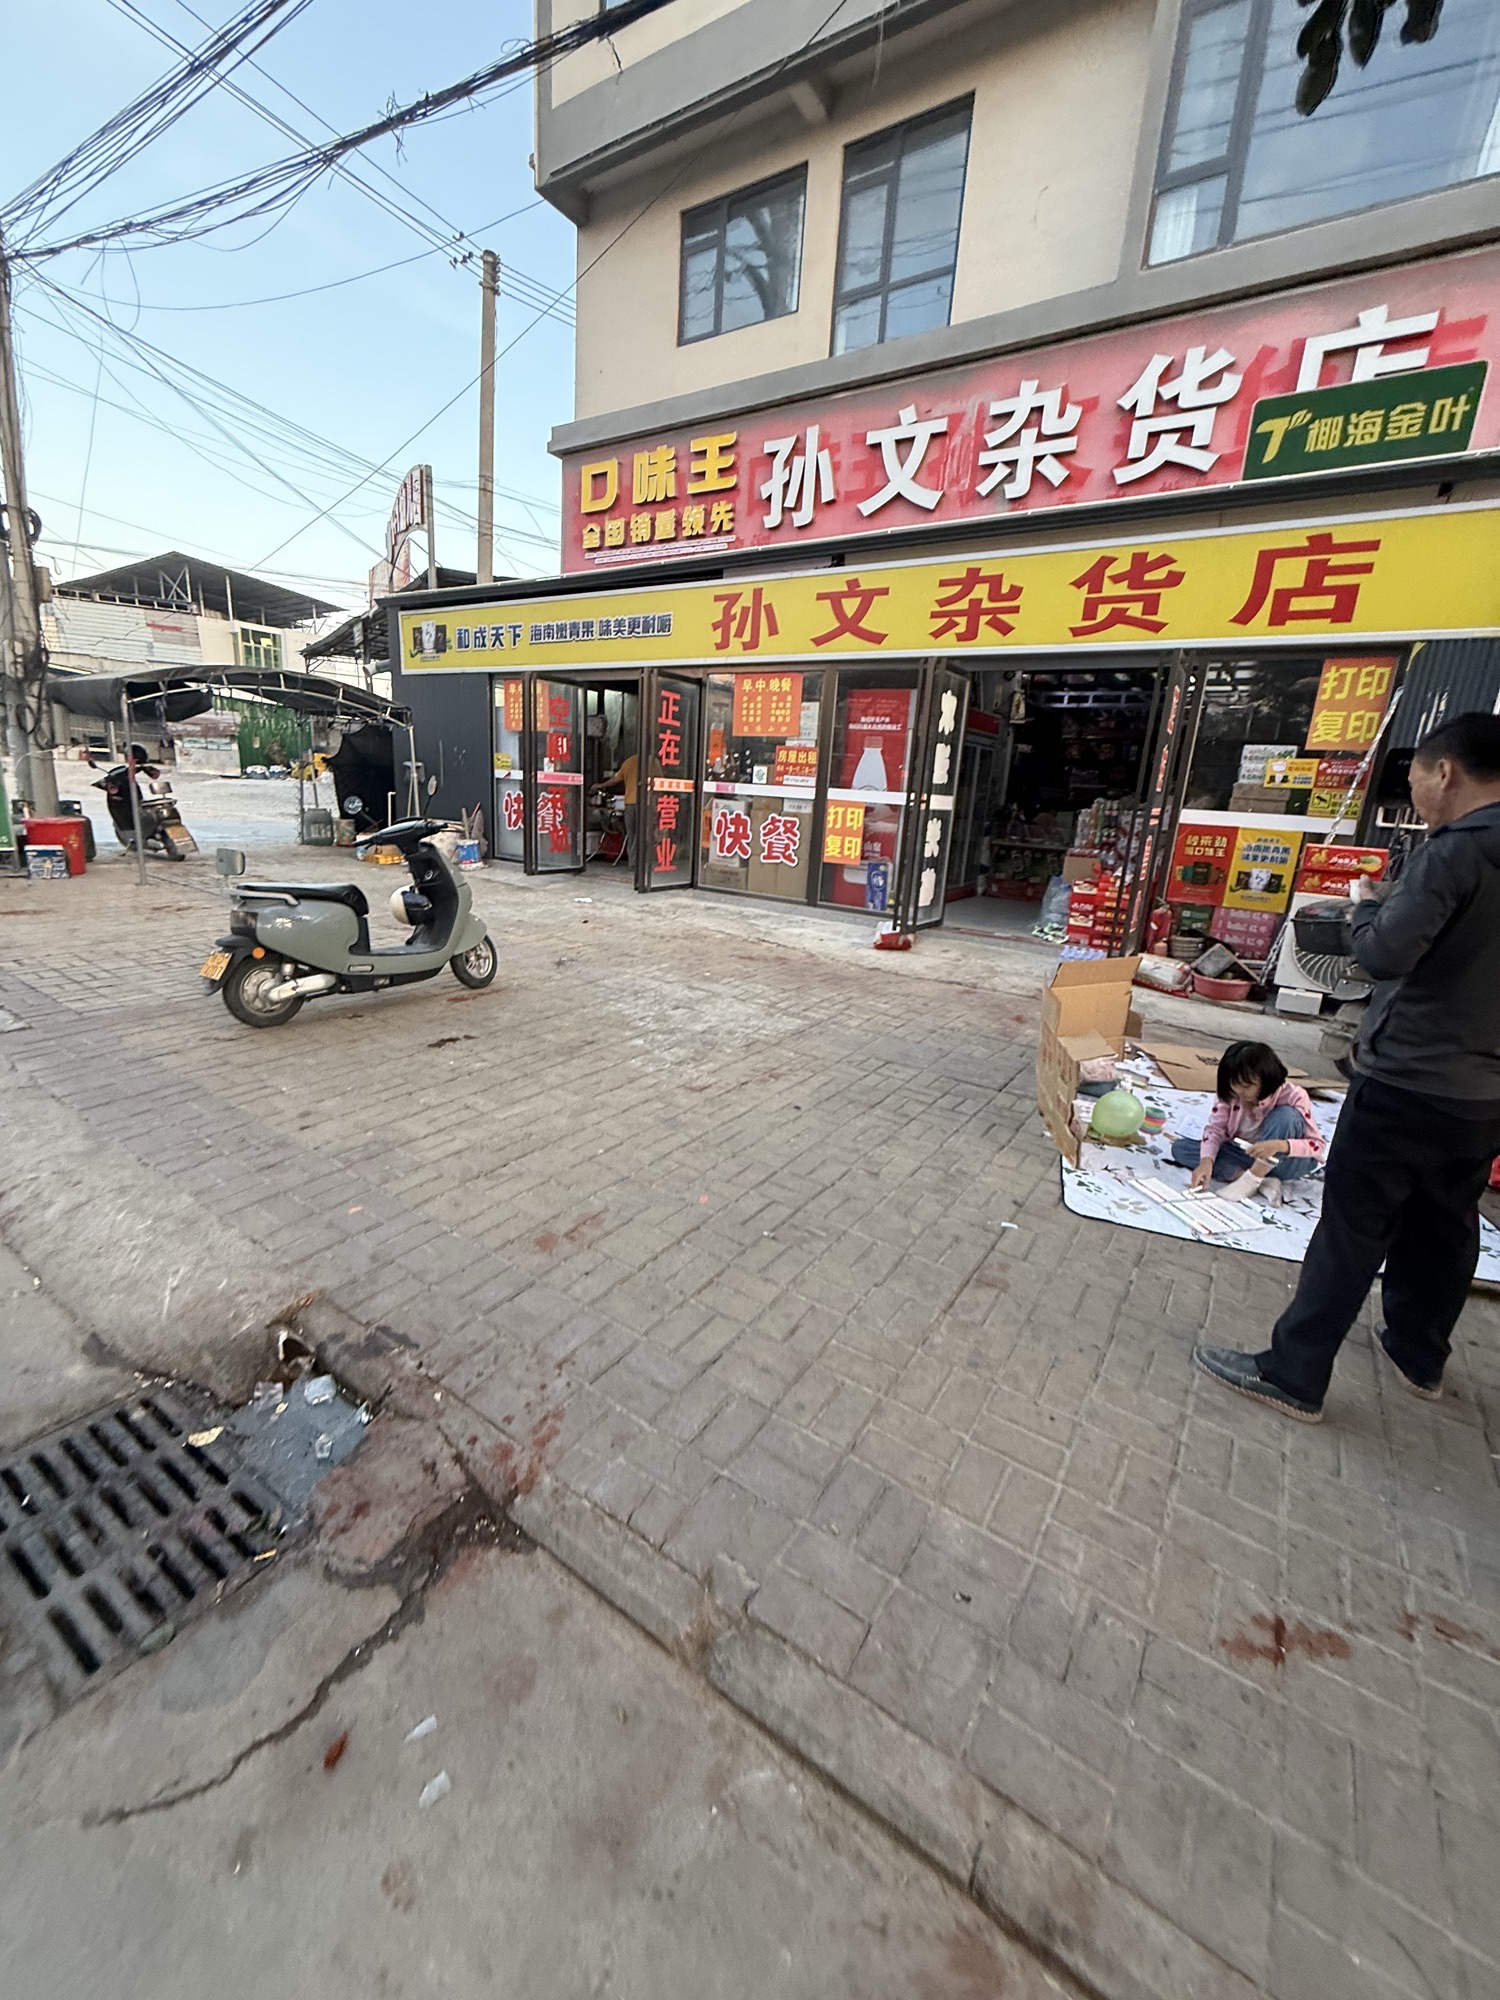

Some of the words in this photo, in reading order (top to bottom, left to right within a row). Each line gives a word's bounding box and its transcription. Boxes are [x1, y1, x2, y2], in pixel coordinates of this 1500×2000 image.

[1305, 394, 1470, 453] 椰海金叶
[581, 431, 737, 514] 口味王
[582, 500, 735, 549] 全国销量领先
[712, 533, 1382, 651] 孙文杂货店
[455, 624, 524, 652] 和成天下
[529, 618, 595, 645] 海南嫩青果
[597, 612, 674, 641] 味美更耐嚼
[1320, 664, 1392, 701] 打印
[1311, 709, 1381, 744] 复印
[778, 749, 817, 764] 房屋出租
[654, 690, 682, 873] 正在营业
[714, 809, 800, 867] 快餐
[827, 805, 864, 830] 打印
[825, 835, 861, 859] 复印
